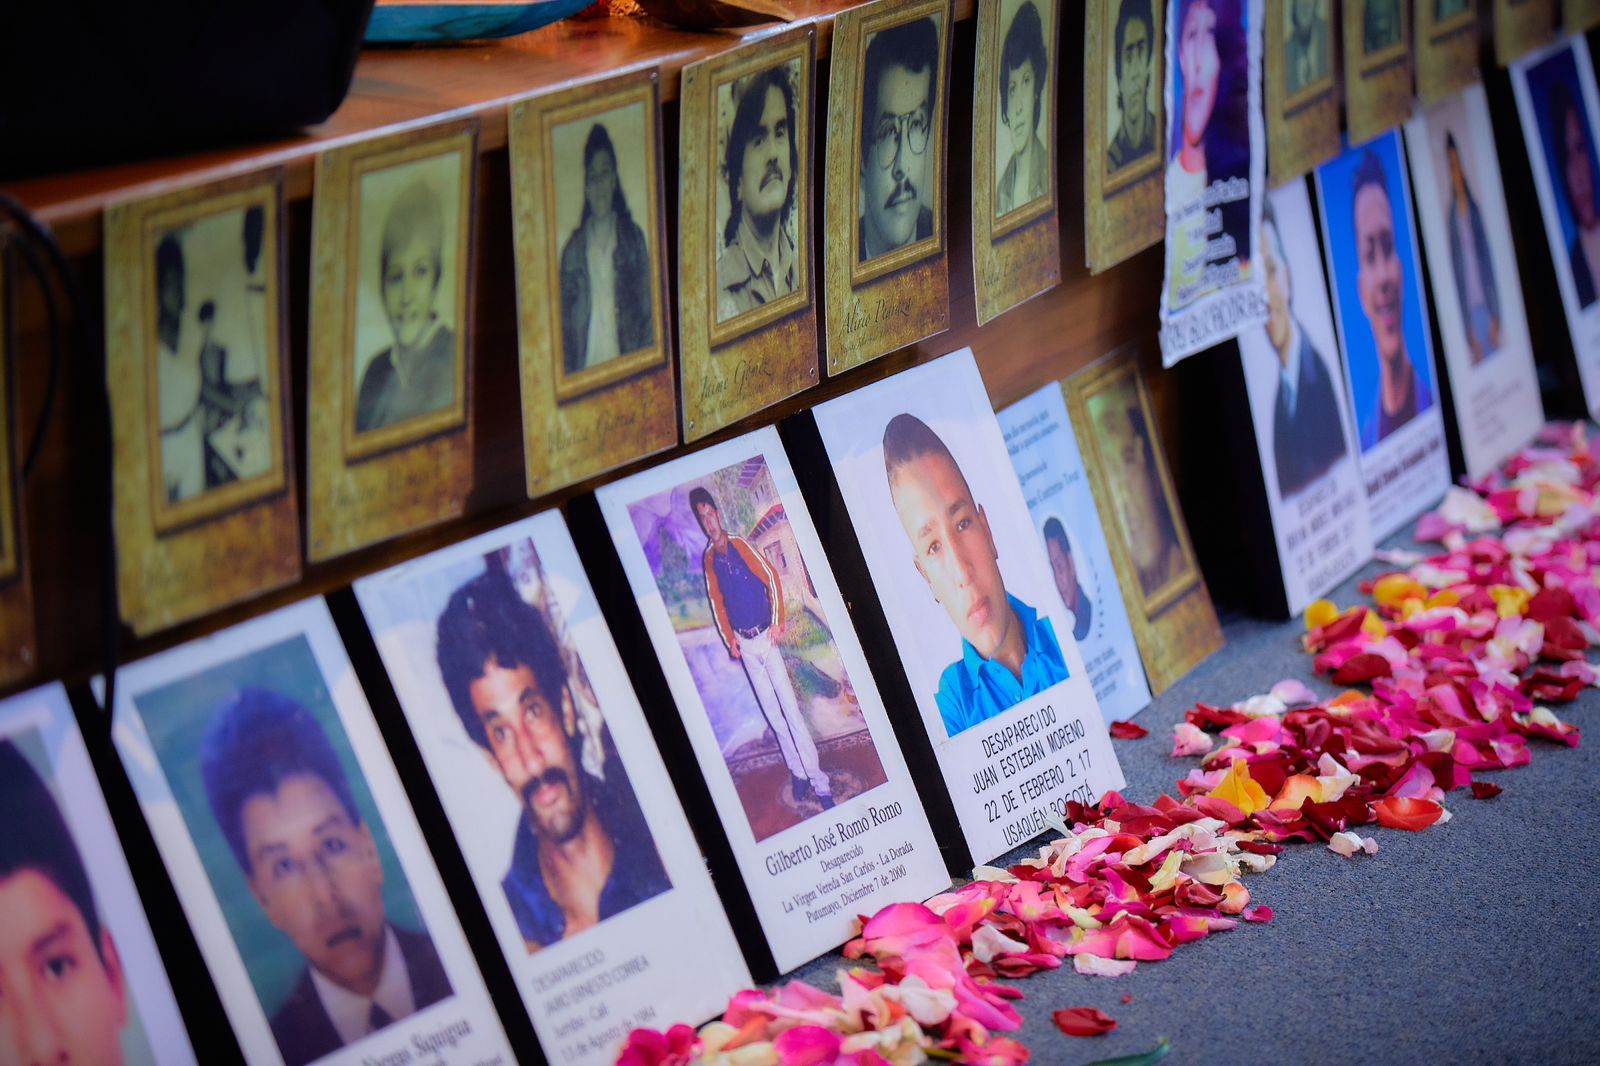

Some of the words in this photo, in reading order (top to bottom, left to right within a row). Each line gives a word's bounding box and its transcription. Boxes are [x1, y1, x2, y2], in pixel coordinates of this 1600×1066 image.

[973, 765, 999, 794] JUAN
[1000, 741, 1046, 779] ESTEBAN
[1046, 719, 1085, 754] MORENO
[982, 705, 1057, 758] DESAPARECIDO
[984, 800, 1001, 823] 22
[1001, 790, 1019, 813] DE
[1019, 765, 1065, 804] FEBRERO
[765, 844, 813, 877] Gilberto
[812, 827, 837, 855] José
[836, 817, 870, 843] Romo
[868, 801, 903, 827] Romo
[1003, 806, 1048, 847] USAQUÉN
[782, 899, 794, 914] La
[792, 889, 817, 907] Virgen
[816, 876, 841, 896] Vereda
[840, 871, 854, 886] San
[853, 861, 876, 878] Carlos
[878, 853, 890, 866] La
[889, 841, 914, 861] Dorada
[820, 844, 864, 873] Desaparecido
[805, 901, 842, 923] Putumayo,
[840, 882, 875, 906] Diciembre
[873, 877, 880, 889] 7
[880, 875, 890, 887] de
[888, 864, 907, 882] 2000
